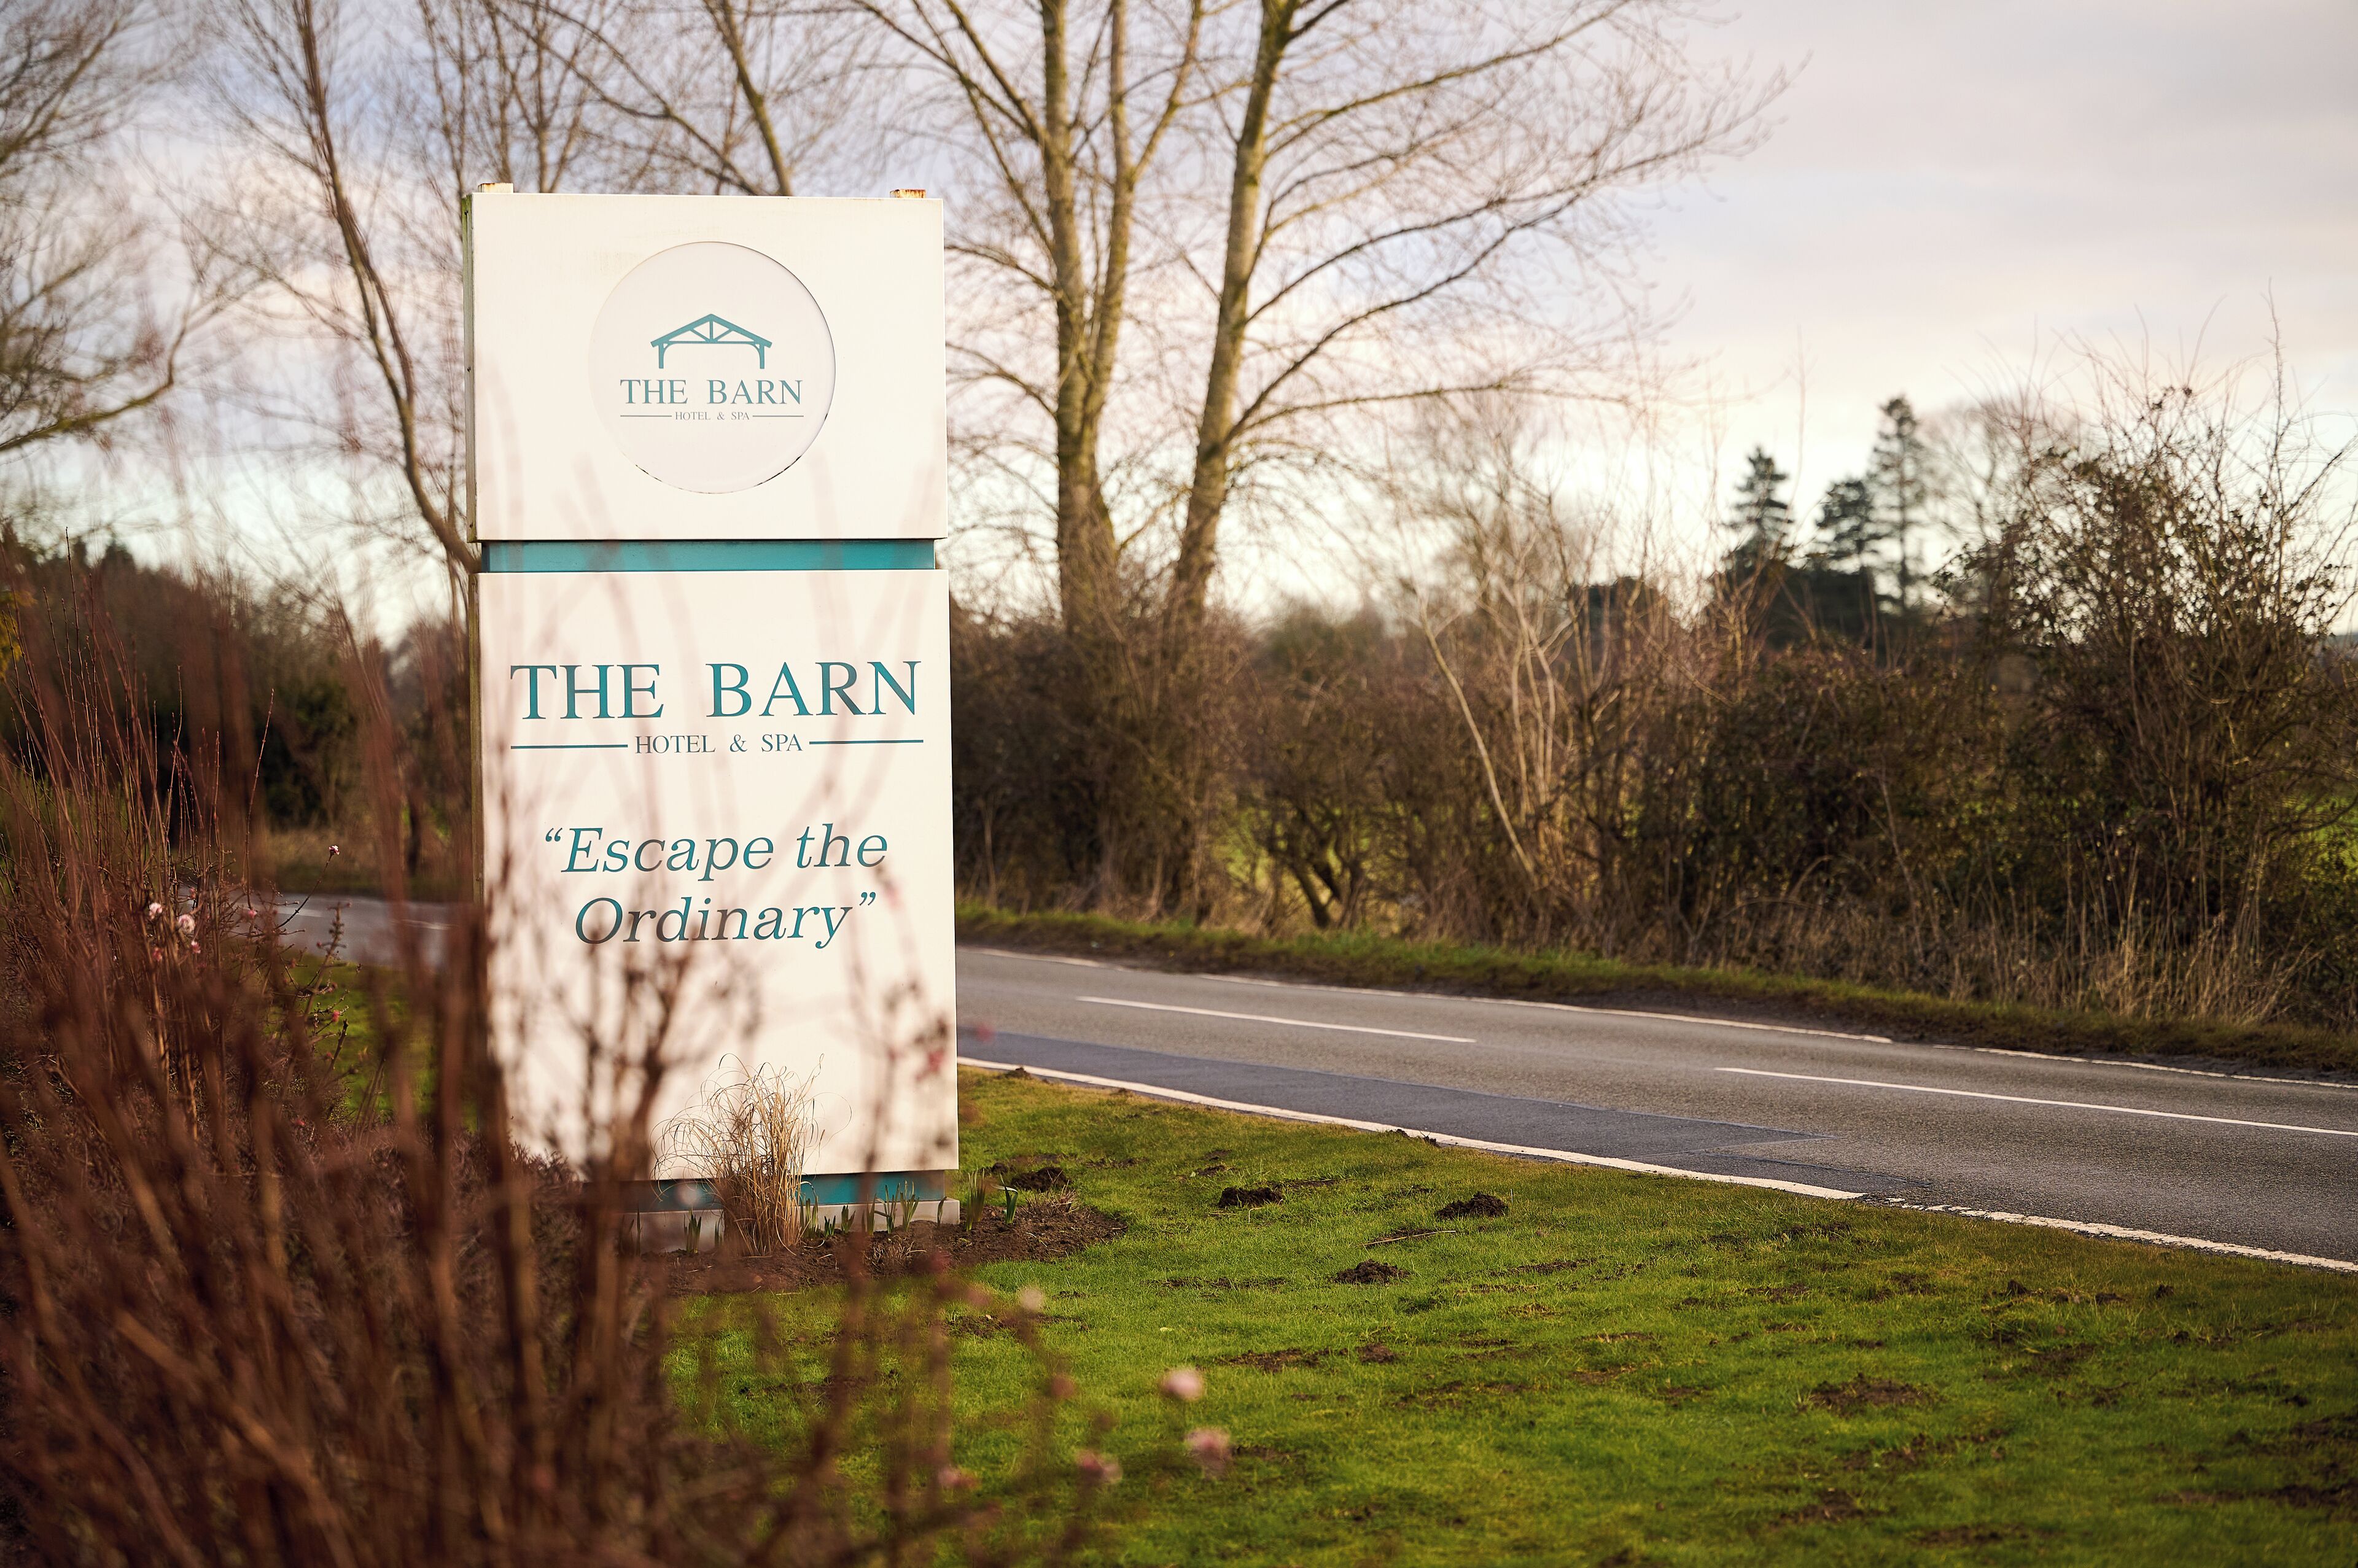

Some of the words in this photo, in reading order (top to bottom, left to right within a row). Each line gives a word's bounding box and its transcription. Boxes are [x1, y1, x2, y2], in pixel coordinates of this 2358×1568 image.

[620, 379, 688, 405] THE
[706, 379, 803, 405] BARN
[675, 411, 711, 421] HOTEL
[717, 411, 725, 421] &
[731, 411, 750, 421] SPA
[510, 664, 664, 720] THE
[705, 661, 922, 718] BARN
[634, 735, 716, 755] HOTEL
[729, 734, 748, 753] &
[761, 732, 803, 752] SPA
[544, 826, 774, 882] “Escape
[796, 823, 888, 869] the
[574, 891, 876, 950] Ordinary”
